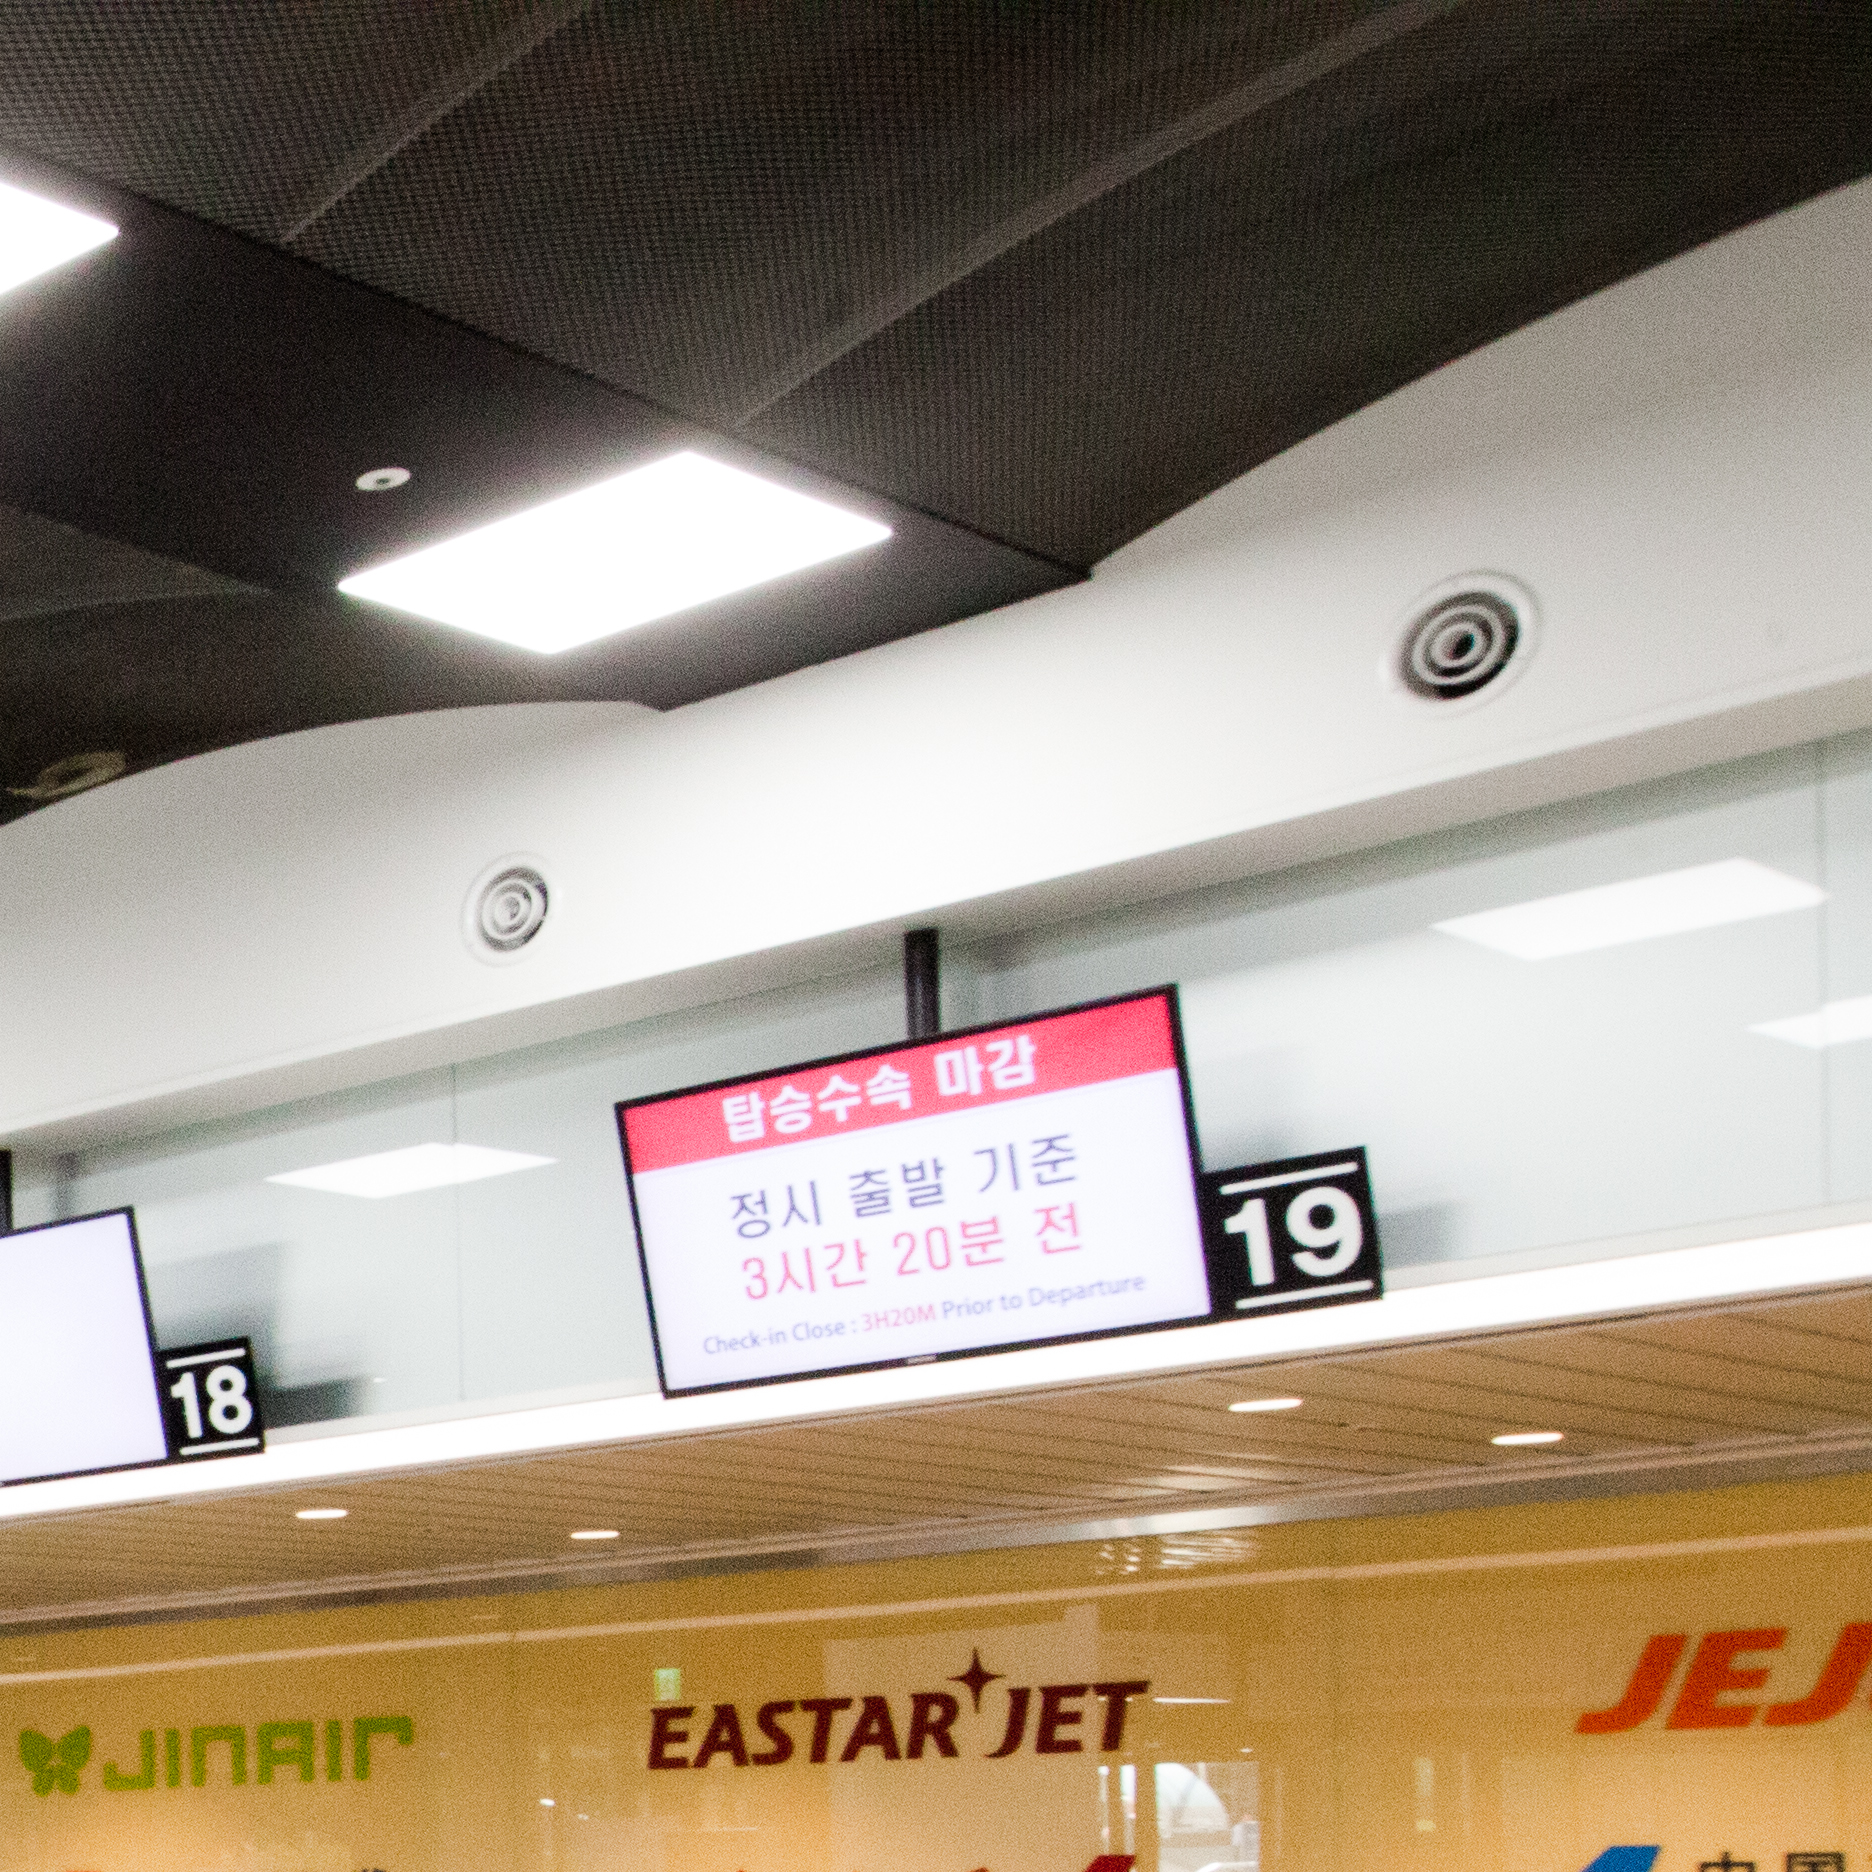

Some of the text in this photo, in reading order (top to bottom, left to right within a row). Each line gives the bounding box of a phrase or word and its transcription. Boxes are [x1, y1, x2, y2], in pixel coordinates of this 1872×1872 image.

[721, 1034, 1037, 1143] 탑승수속 마감
[730, 1133, 1077, 1239] 정시 출발 기준
[742, 1202, 1081, 1301] 3시간 20분 전
[1224, 1186, 1363, 1288] 19
[703, 1328, 787, 1354] Check-in
[792, 1319, 845, 1343] Close
[861, 1304, 937, 1332] 3H20M
[942, 1299, 994, 1320] Prior
[999, 1293, 1024, 1310] to
[1028, 1275, 1146, 1308] Departure
[170, 1365, 254, 1440] 18
[648, 1680, 1152, 1770] EASTAR JET
[1575, 1622, 1872, 1734] JEJ
